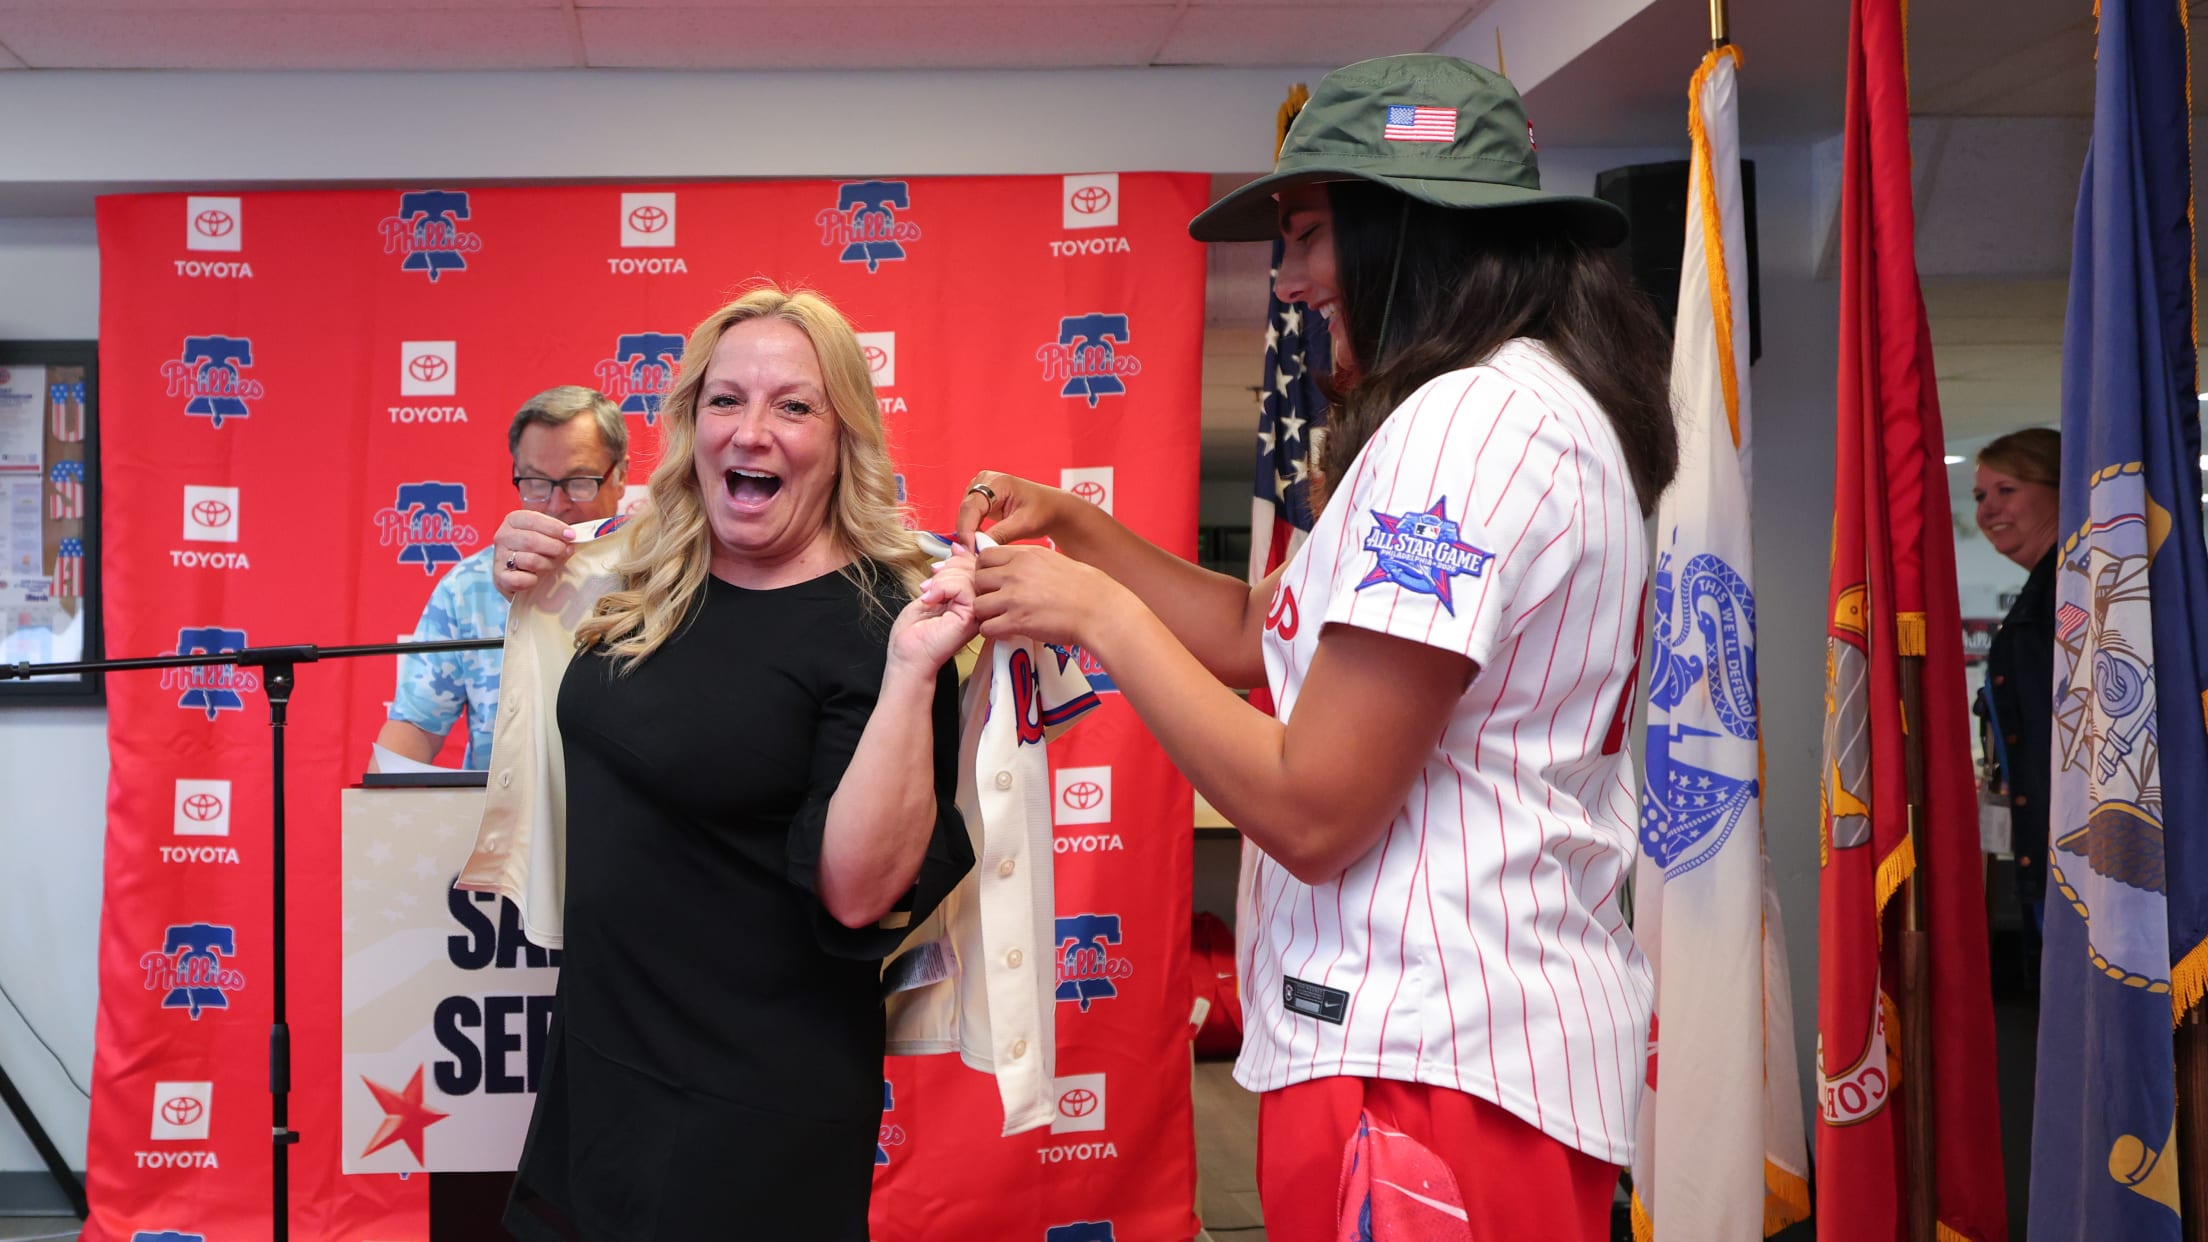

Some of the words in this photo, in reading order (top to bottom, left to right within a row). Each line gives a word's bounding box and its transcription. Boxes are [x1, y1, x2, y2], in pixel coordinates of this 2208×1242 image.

[379, 216, 482, 254] Phillies
[815, 208, 921, 246] Phillies
[1050, 237, 1130, 257] TOYOTA
[175, 260, 253, 278] TOYOTA
[607, 259, 688, 274] TOYOTA
[1036, 342, 1141, 381] Phillies
[161, 361, 263, 399] Phillies
[594, 358, 672, 397] Philli
[388, 407, 468, 422] TOYOTA
[374, 508, 479, 547] Phillies
[170, 551, 249, 569] TOYOTA
[1381, 549, 1433, 566] PHILADELPHIA
[1436, 542, 1483, 572] GAME
[1698, 579, 1729, 603] THIS
[1722, 608, 1738, 655] WE'LL
[1728, 659, 1753, 716] DEFEND
[160, 847, 240, 865] TOYOTA
[1053, 835, 1124, 854] OYOTA
[140, 952, 245, 992] Phillies
[135, 1152, 218, 1168] TOYOTA
[1038, 1143, 1117, 1163] TOYOTA
